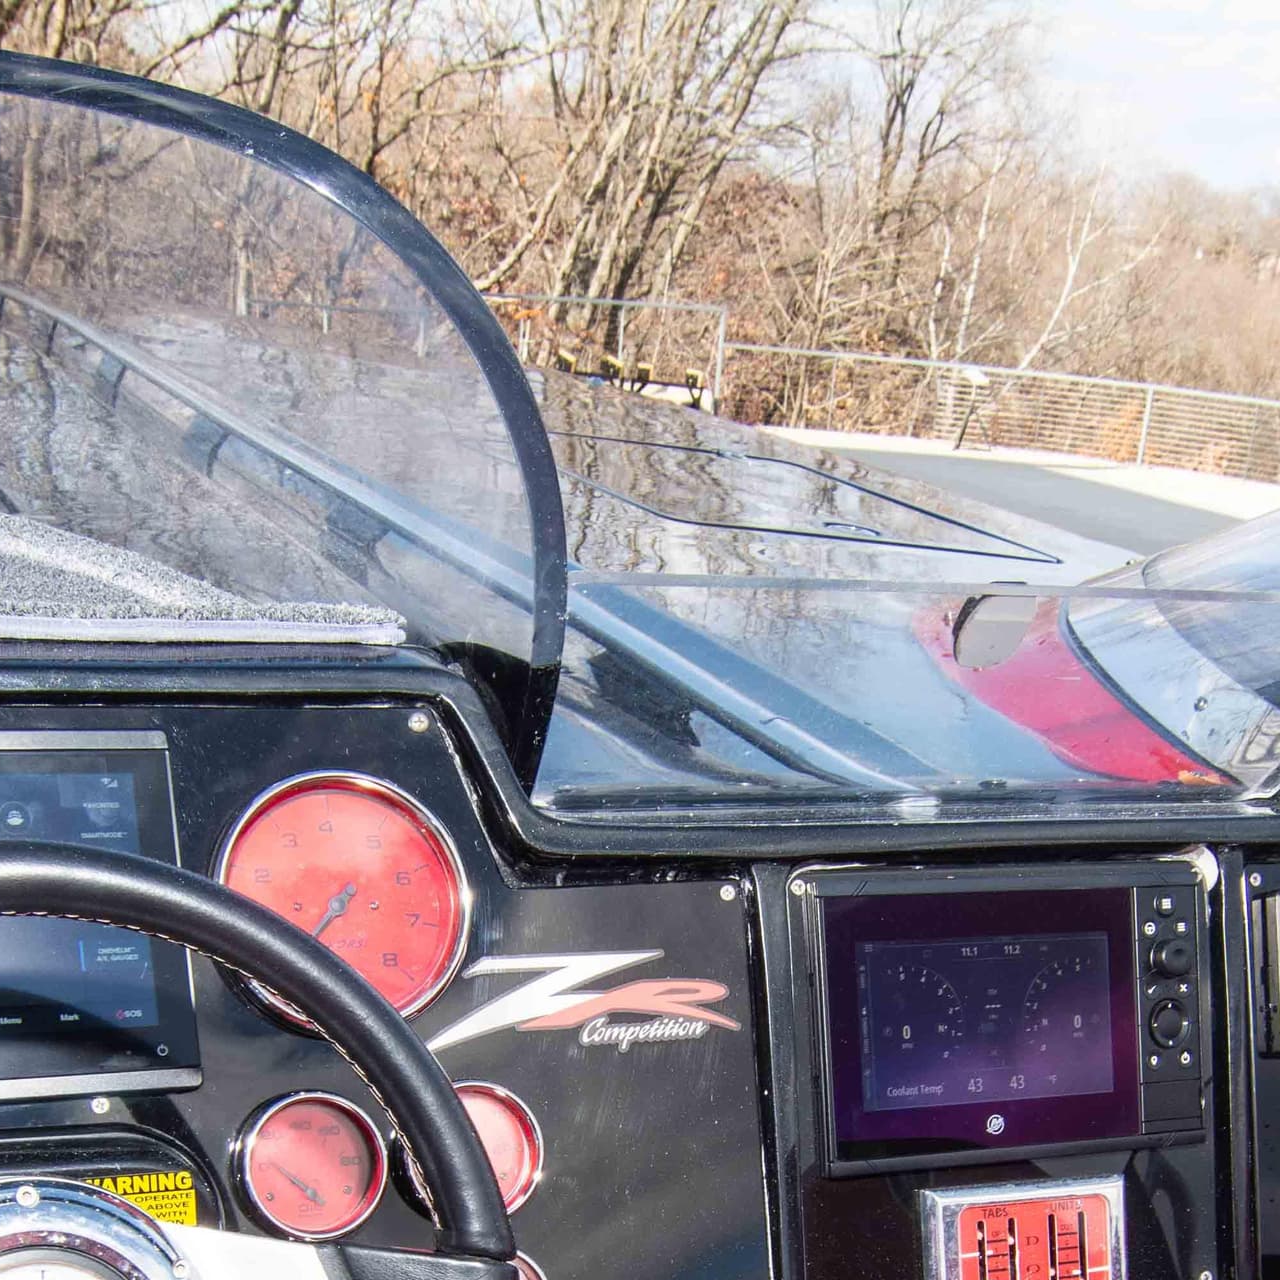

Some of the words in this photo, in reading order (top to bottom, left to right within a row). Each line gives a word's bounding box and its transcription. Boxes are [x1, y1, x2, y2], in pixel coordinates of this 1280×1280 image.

[124, 1010, 142, 1018] SOS
[581, 1017, 707, 1050] Competition
[886, 1086, 919, 1097] Coolant
[920, 1084, 943, 1096] Temp
[968, 1078, 983, 1093] 43
[1009, 1075, 1024, 1089] 43
[135, 1192, 193, 1203] OPERATE
